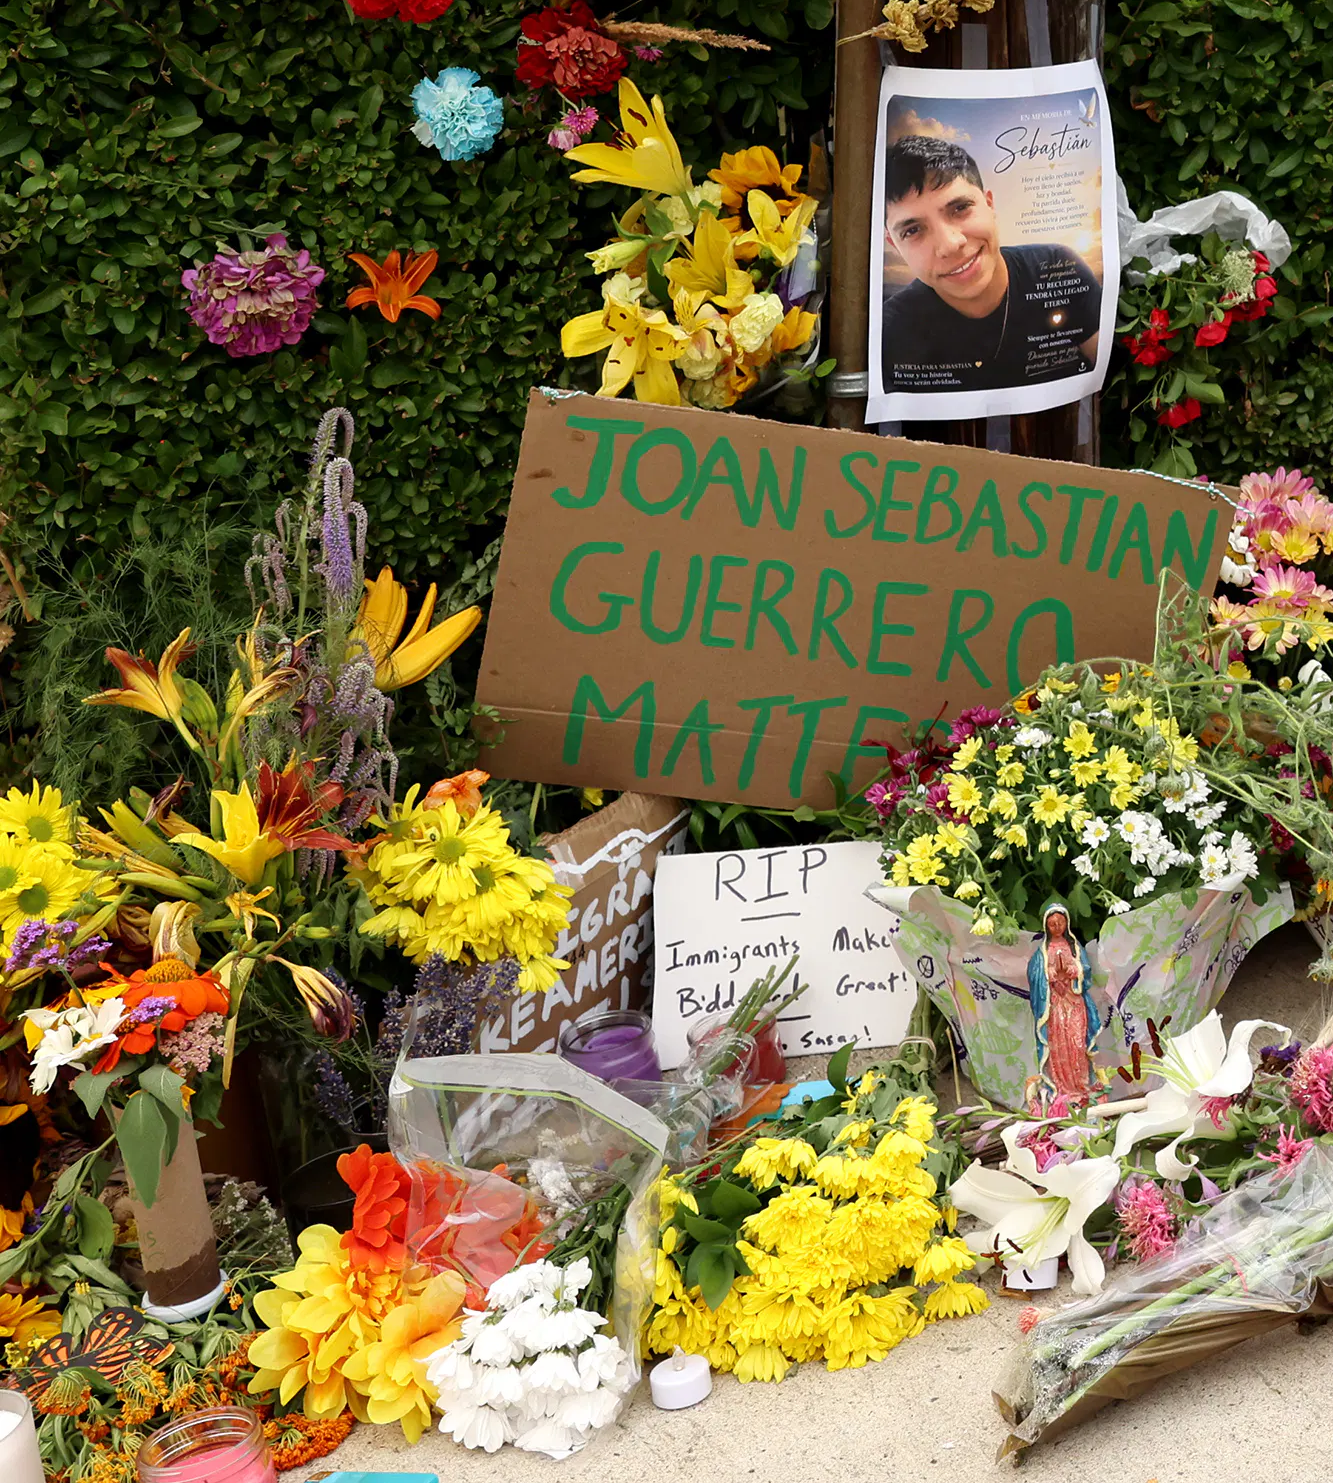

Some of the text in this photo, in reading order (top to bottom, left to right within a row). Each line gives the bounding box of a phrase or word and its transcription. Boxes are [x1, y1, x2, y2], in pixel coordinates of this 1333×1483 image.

[1046, 278, 1081, 289] RECUERDO
[1064, 285, 1090, 295] LEGADO
[551, 414, 1219, 589] JOAN SEBASTIAN
[549, 541, 1077, 697] GUERRERO
[714, 846, 828, 904] RIP
[665, 926, 891, 974] Immigrants Make
[835, 971, 908, 998] Great!
